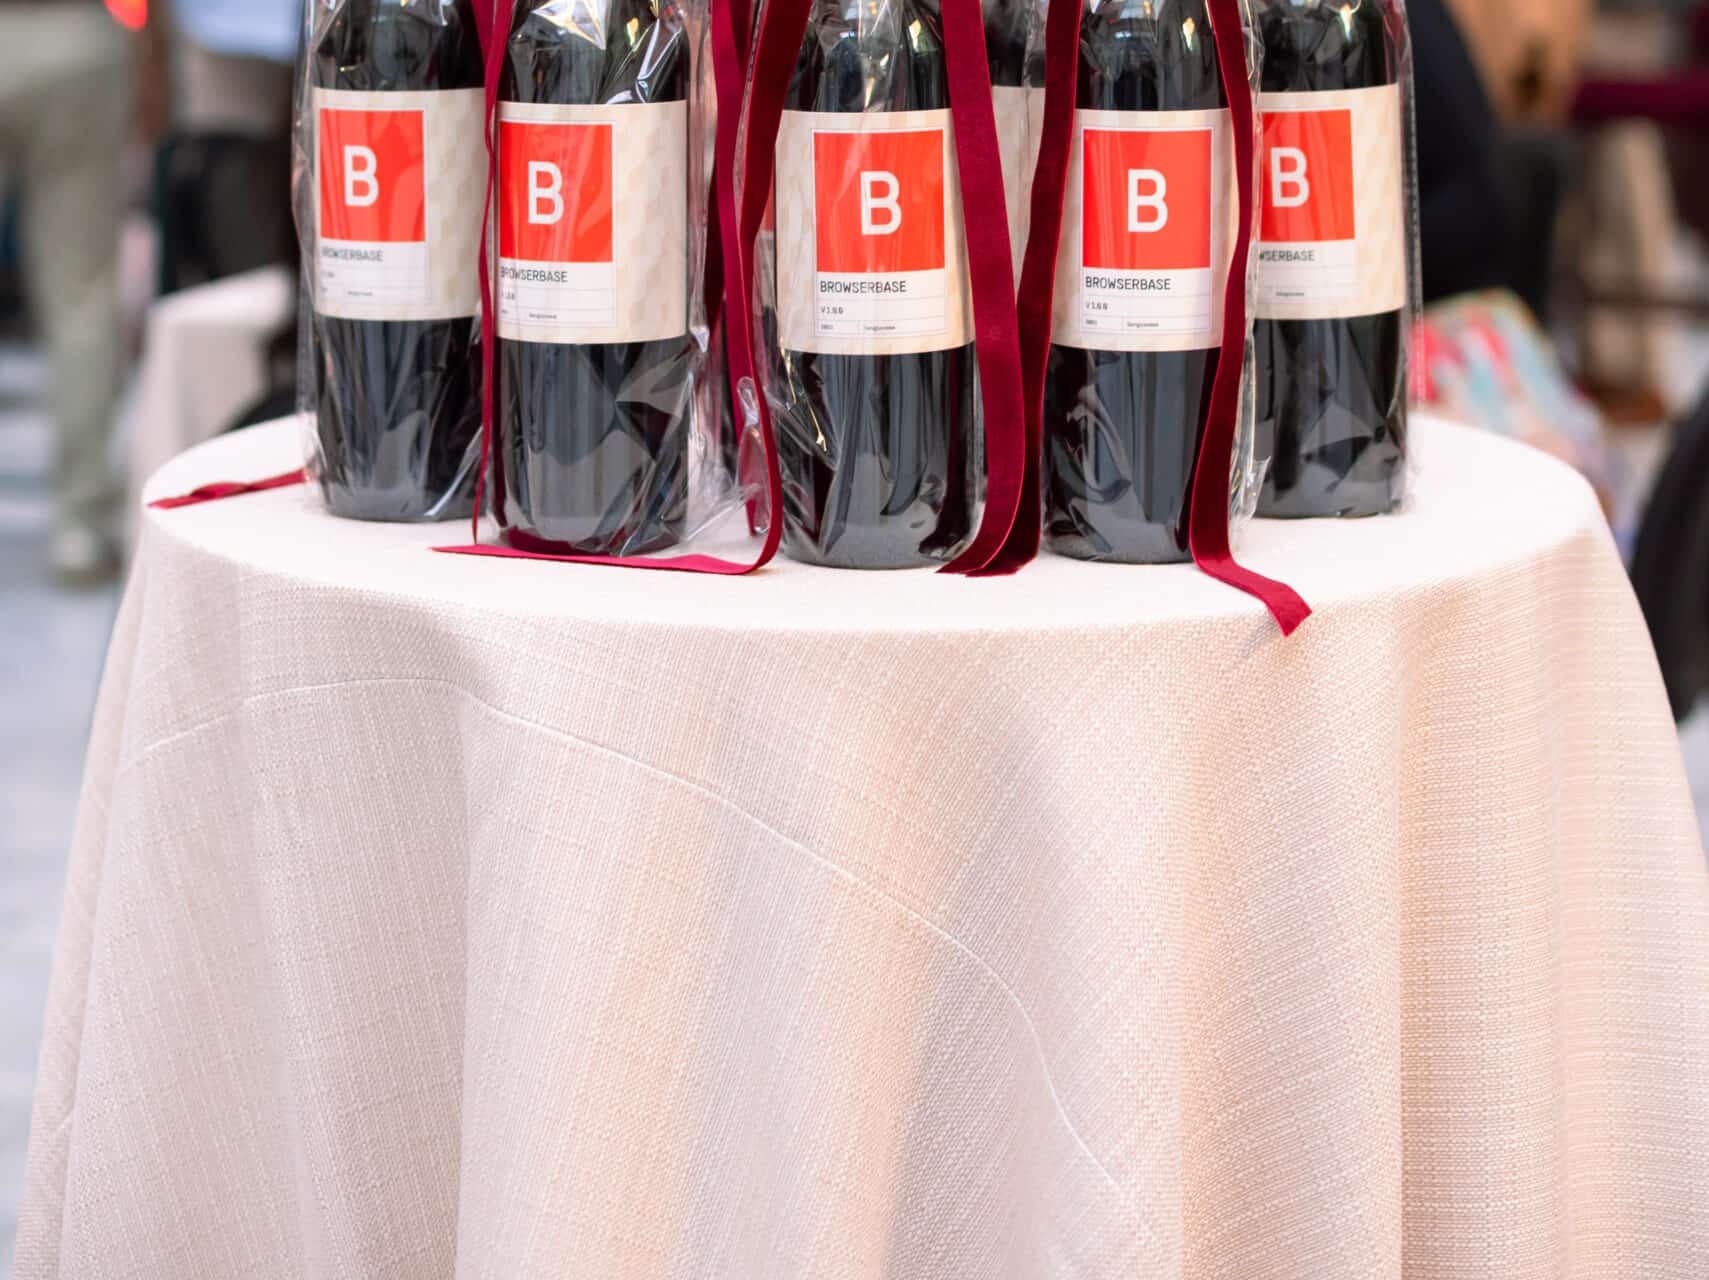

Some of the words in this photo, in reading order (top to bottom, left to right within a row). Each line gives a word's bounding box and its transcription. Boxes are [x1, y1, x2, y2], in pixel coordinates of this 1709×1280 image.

[344, 144, 379, 206] B
[528, 160, 564, 224] B
[860, 171, 902, 235] B
[1128, 168, 1168, 232] B
[1271, 147, 1310, 208] B
[820, 280, 907, 294] BROWSERBASE
[1085, 276, 1171, 290] BROWSERBASE
